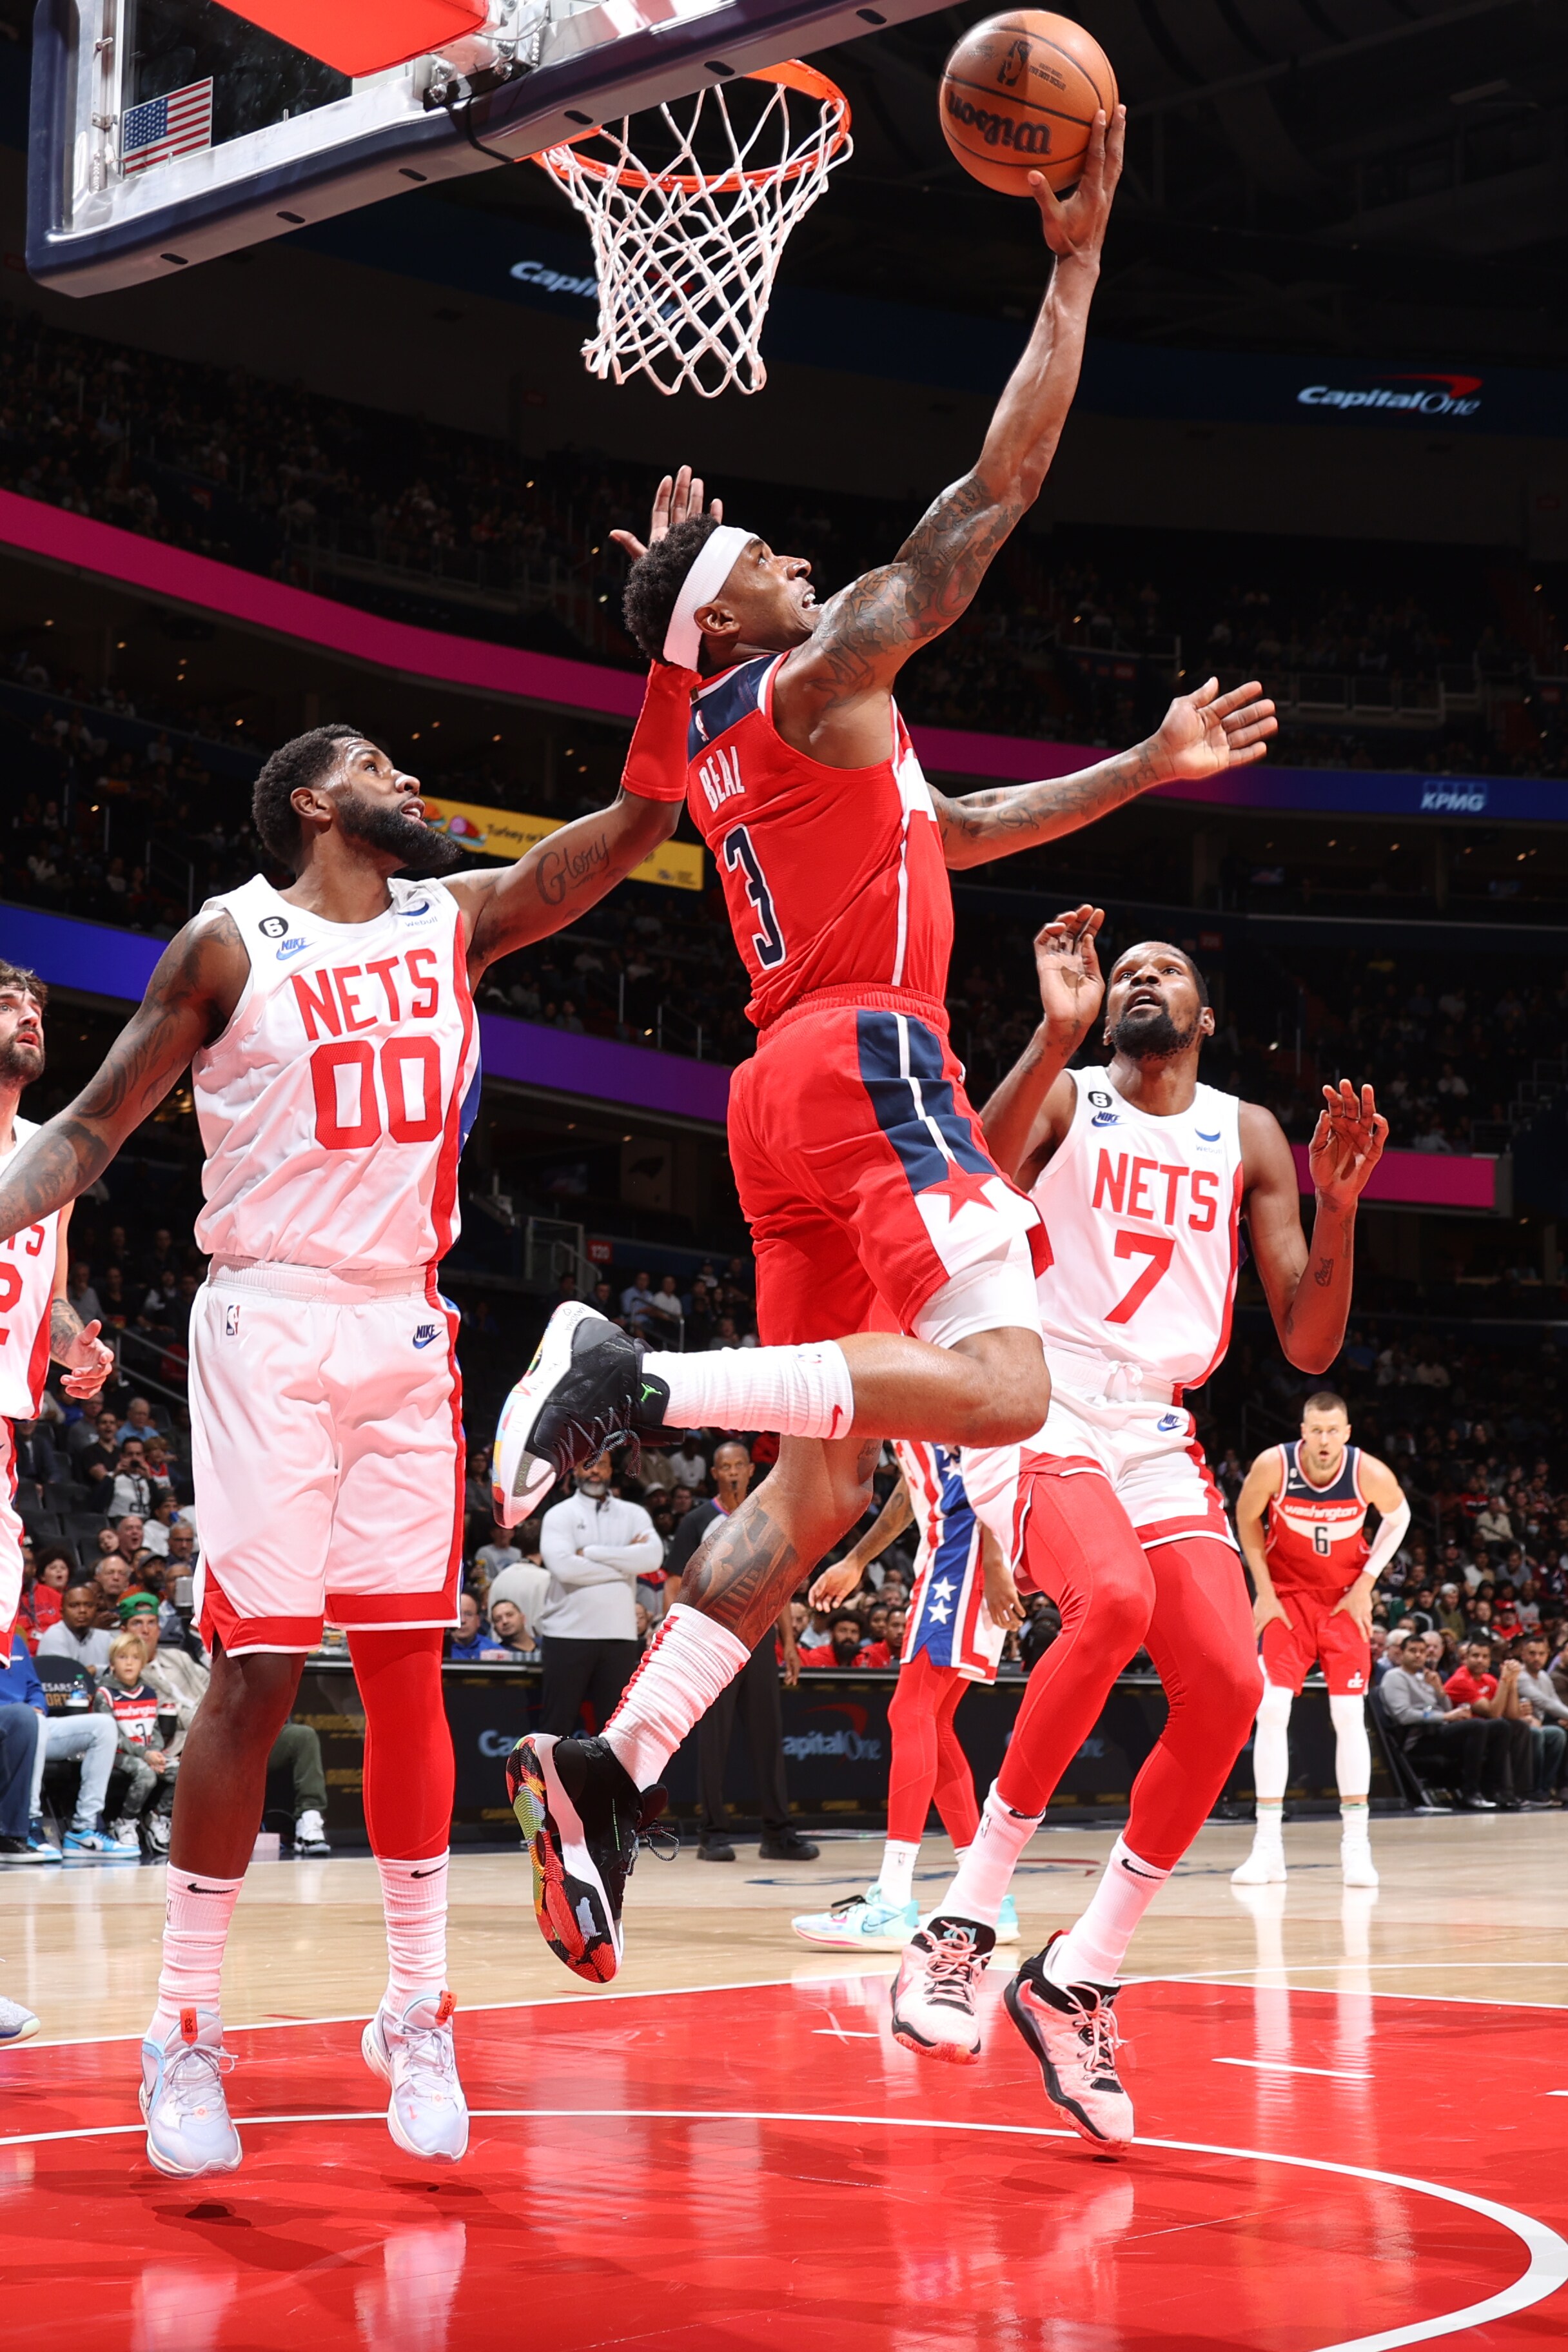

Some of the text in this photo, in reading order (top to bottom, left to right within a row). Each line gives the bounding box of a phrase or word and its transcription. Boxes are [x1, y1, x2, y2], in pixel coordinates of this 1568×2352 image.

[947, 91, 1052, 155] Wilson
[699, 746, 745, 813] BEAL
[1420, 792, 1485, 812] KPMG
[535, 834, 610, 905] Glory
[723, 823, 787, 971] 3
[262, 917, 283, 936] 6
[404, 916, 438, 928] Webull
[280, 937, 307, 952] NIKE
[291, 948, 439, 1041] NETS
[310, 1036, 443, 1150] 00
[1092, 1093, 1109, 1108] 6
[1097, 1111, 1121, 1123] NIKE
[1195, 1145, 1222, 1154] Webull
[1092, 1148, 1219, 1232] NETS
[1104, 1230, 1176, 1324] 7
[415, 1324, 435, 1339] NIKE
[1284, 1504, 1358, 1522] washington
[1314, 1525, 1329, 1556] 6
